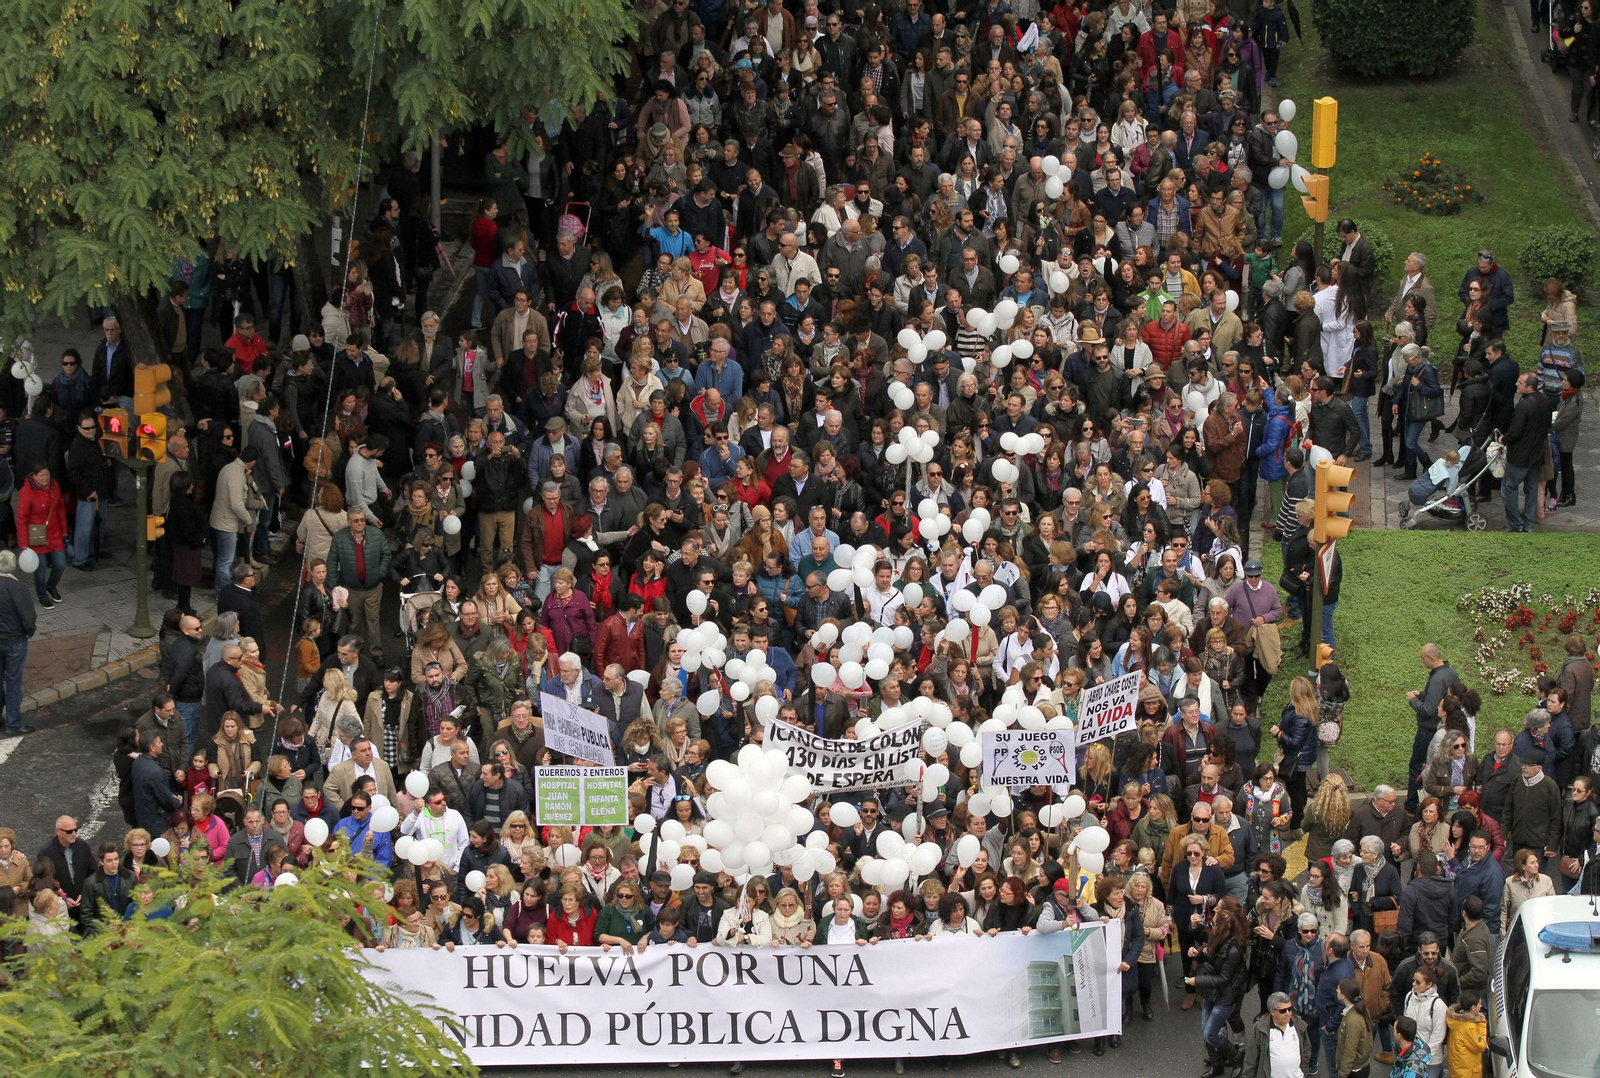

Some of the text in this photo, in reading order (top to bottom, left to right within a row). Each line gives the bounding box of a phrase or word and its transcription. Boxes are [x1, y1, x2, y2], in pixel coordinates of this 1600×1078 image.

[1086, 695, 1125, 716] NOS VA
[1082, 702, 1132, 730] LA VIDA
[996, 732, 1057, 742] SU JUEGO
[1080, 719, 1127, 743] EN ELLO
[553, 734, 604, 764] DE CALIDAD
[848, 741, 867, 754] DE
[994, 748, 1008, 757] PP
[1050, 745, 1063, 754] PSOE
[786, 746, 817, 768] 130
[864, 753, 885, 770] EN
[1012, 744, 1047, 771] CHARE COSTA
[539, 768, 625, 777] QUEREMOS 2 ENTEROS
[807, 772, 824, 787] DE
[832, 769, 894, 788] ESPERA
[541, 781, 577, 790] HOSPITAL
[587, 781, 623, 789] HOSPITAL
[991, 775, 1070, 786] NUESTRA VIDA
[546, 792, 568, 800] JUAN
[589, 795, 619, 803] INFANTA
[590, 807, 616, 816] ELENA
[463, 951, 874, 993] HUELVA, POR UNA
[1077, 949, 1086, 990] Hospital
[415, 1001, 970, 1049] NIDAD PÚBLICA DIGNA
